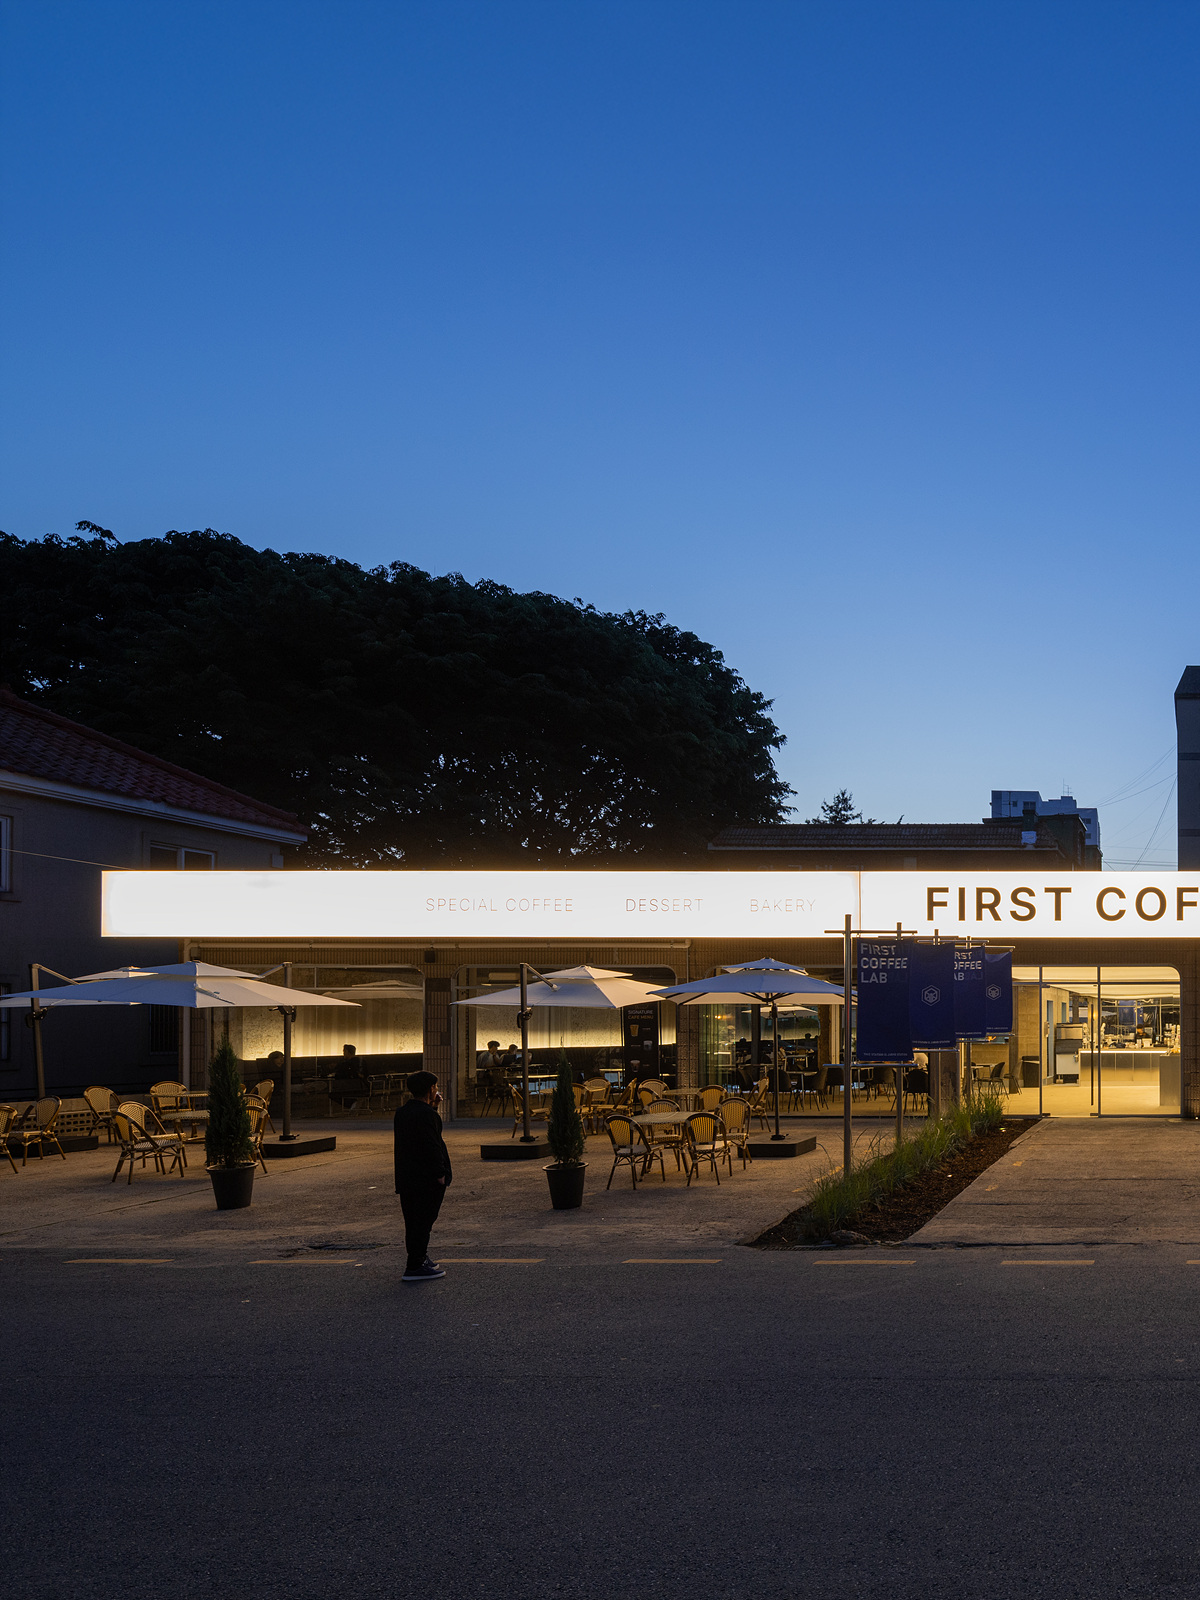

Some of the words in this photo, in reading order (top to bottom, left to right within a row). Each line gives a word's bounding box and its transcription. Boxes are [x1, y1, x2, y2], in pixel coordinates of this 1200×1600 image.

[425, 897, 498, 912] SPECIAL
[505, 897, 574, 912] COFFEE
[625, 897, 704, 912] DESSERT
[749, 897, 817, 912] BAKERY
[926, 886, 1072, 922] FIRST
[860, 943, 897, 956] FIRST
[954, 951, 973, 960] RST
[860, 957, 908, 969] COFFEE
[954, 960, 982, 970] OFFEE
[860, 971, 888, 984] LAB
